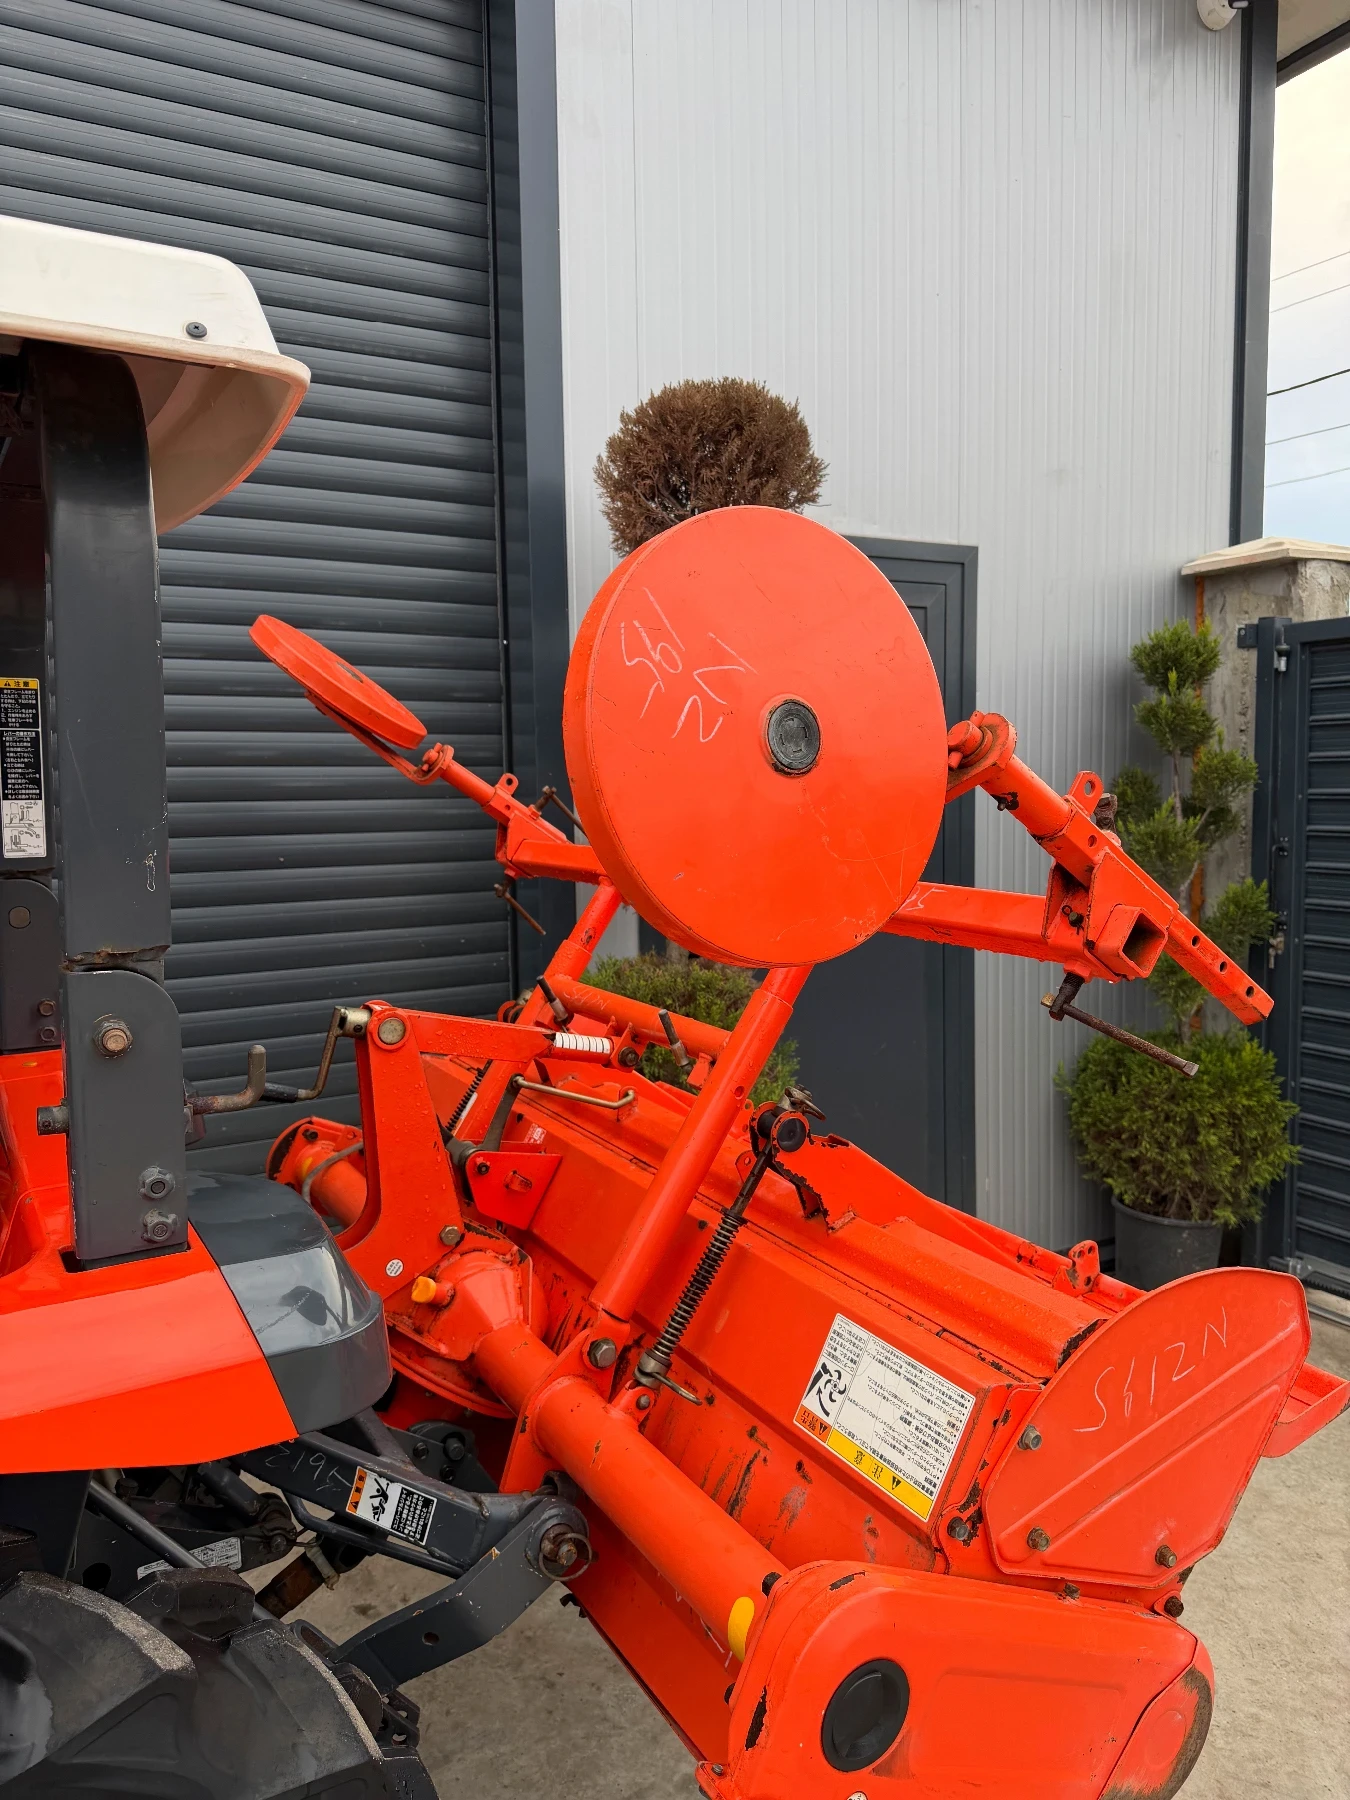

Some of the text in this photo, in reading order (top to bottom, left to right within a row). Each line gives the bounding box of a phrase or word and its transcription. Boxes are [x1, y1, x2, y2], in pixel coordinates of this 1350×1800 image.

[1073, 1305, 1227, 1432] S612N
[798, 1408, 819, 1432] 警告
[852, 1448, 884, 1480] 注意
